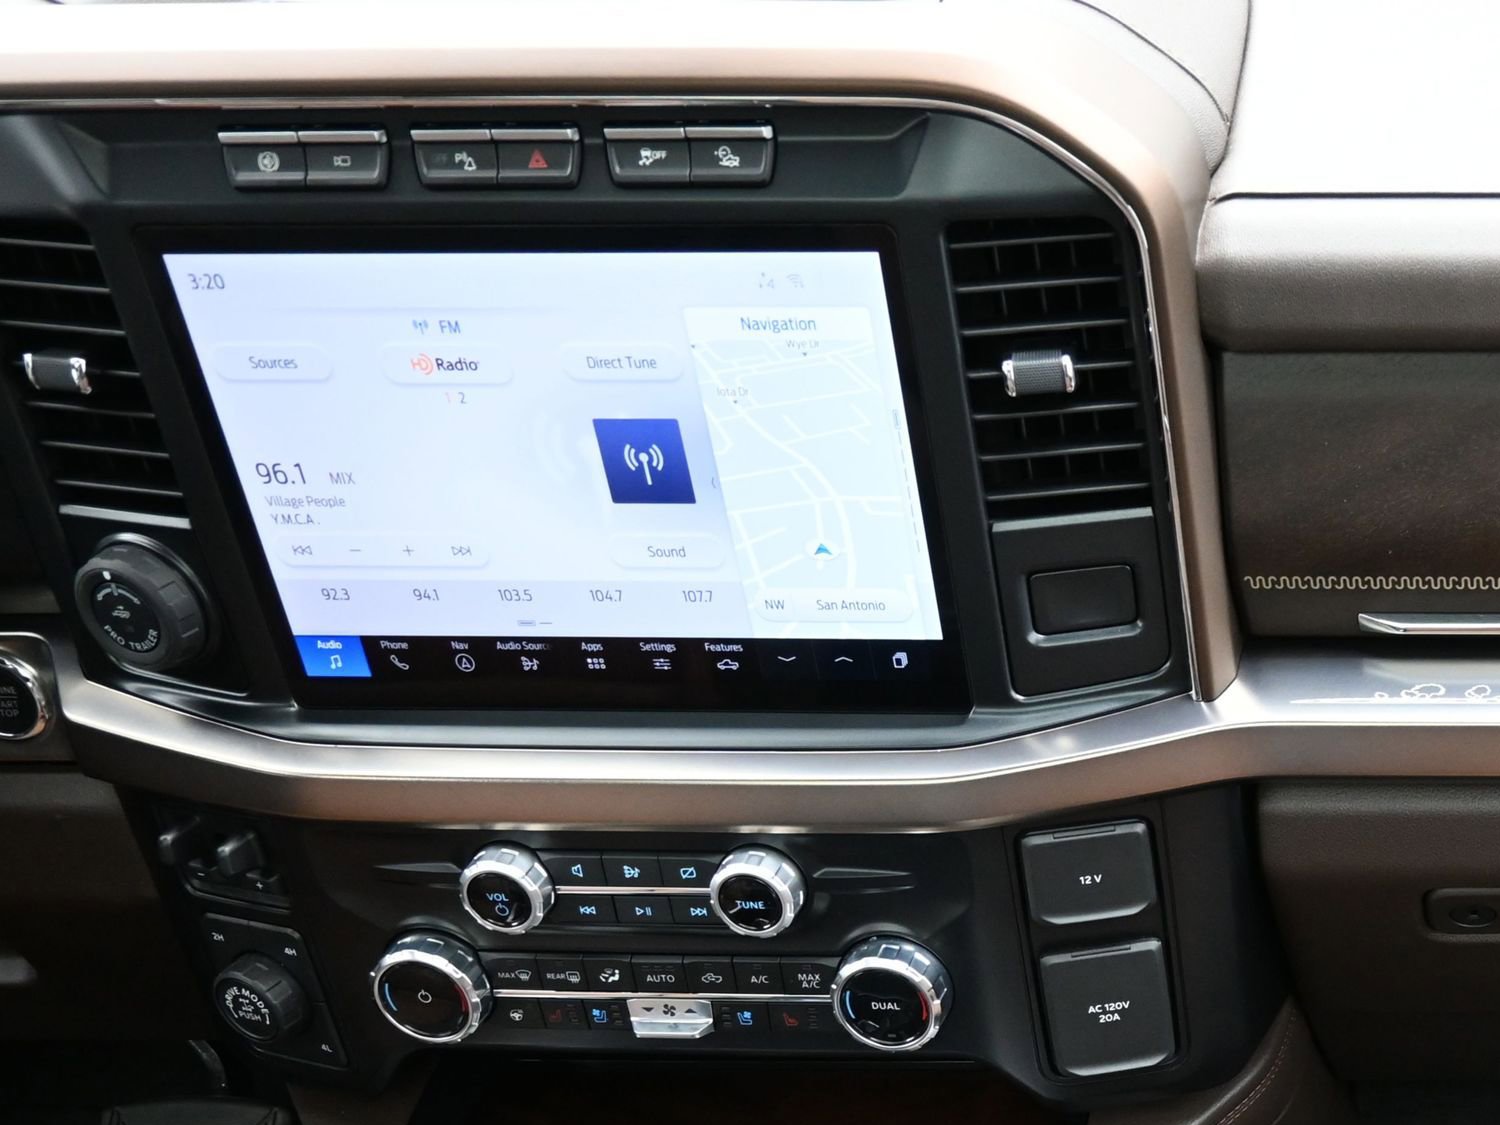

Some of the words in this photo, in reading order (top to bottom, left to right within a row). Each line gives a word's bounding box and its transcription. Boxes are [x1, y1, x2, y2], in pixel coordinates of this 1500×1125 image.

[187, 273, 226, 291] 3:20
[438, 319, 462, 335] FM
[739, 317, 817, 334] Navigation
[248, 355, 299, 370] Sources
[435, 357, 479, 373] Radio
[585, 355, 624, 370] Direct
[625, 356, 658, 370] Tune
[255, 462, 307, 485] 96.1
[328, 471, 356, 486] MIX
[265, 495, 305, 509] Village
[306, 496, 346, 510] People
[647, 545, 687, 558] Sound
[321, 587, 351, 601] 92.3
[412, 588, 440, 601] 94.1
[497, 588, 534, 602] 103.5
[589, 588, 623, 602] 104.7
[682, 589, 714, 603] 107.7
[764, 599, 786, 611] NW
[815, 599, 839, 611] San
[840, 599, 887, 612] Antonio
[103, 624, 126, 646] PRO
[128, 628, 159, 651] TRAILER
[317, 639, 343, 650] Audio
[379, 640, 410, 651] Phone
[451, 641, 469, 651] Nav
[496, 641, 522, 651] Audio
[580, 641, 604, 653] Apps
[639, 641, 677, 653] Settings
[703, 642, 744, 653] Features
[1079, 875, 1092, 886] 12
[1093, 873, 1103, 884] V
[486, 892, 510, 902] VOL
[735, 900, 767, 910] TUNE
[211, 931, 225, 942] 2H
[284, 947, 298, 957] 4H
[497, 971, 516, 980] MAX
[546, 972, 567, 981] REAR
[646, 973, 676, 984] AUTO
[750, 974, 770, 985] A/C
[797, 973, 822, 982] MAX
[801, 980, 821, 990] A/C
[224, 986, 241, 1008] DRIVE
[241, 987, 270, 1015] MODE
[870, 1001, 901, 1011] DUAL
[1087, 1004, 1103, 1014] AC
[1104, 1000, 1131, 1013] 120V
[238, 1010, 262, 1022] PUSH
[1098, 1013, 1121, 1024] 20A
[321, 1043, 333, 1053] 4L
